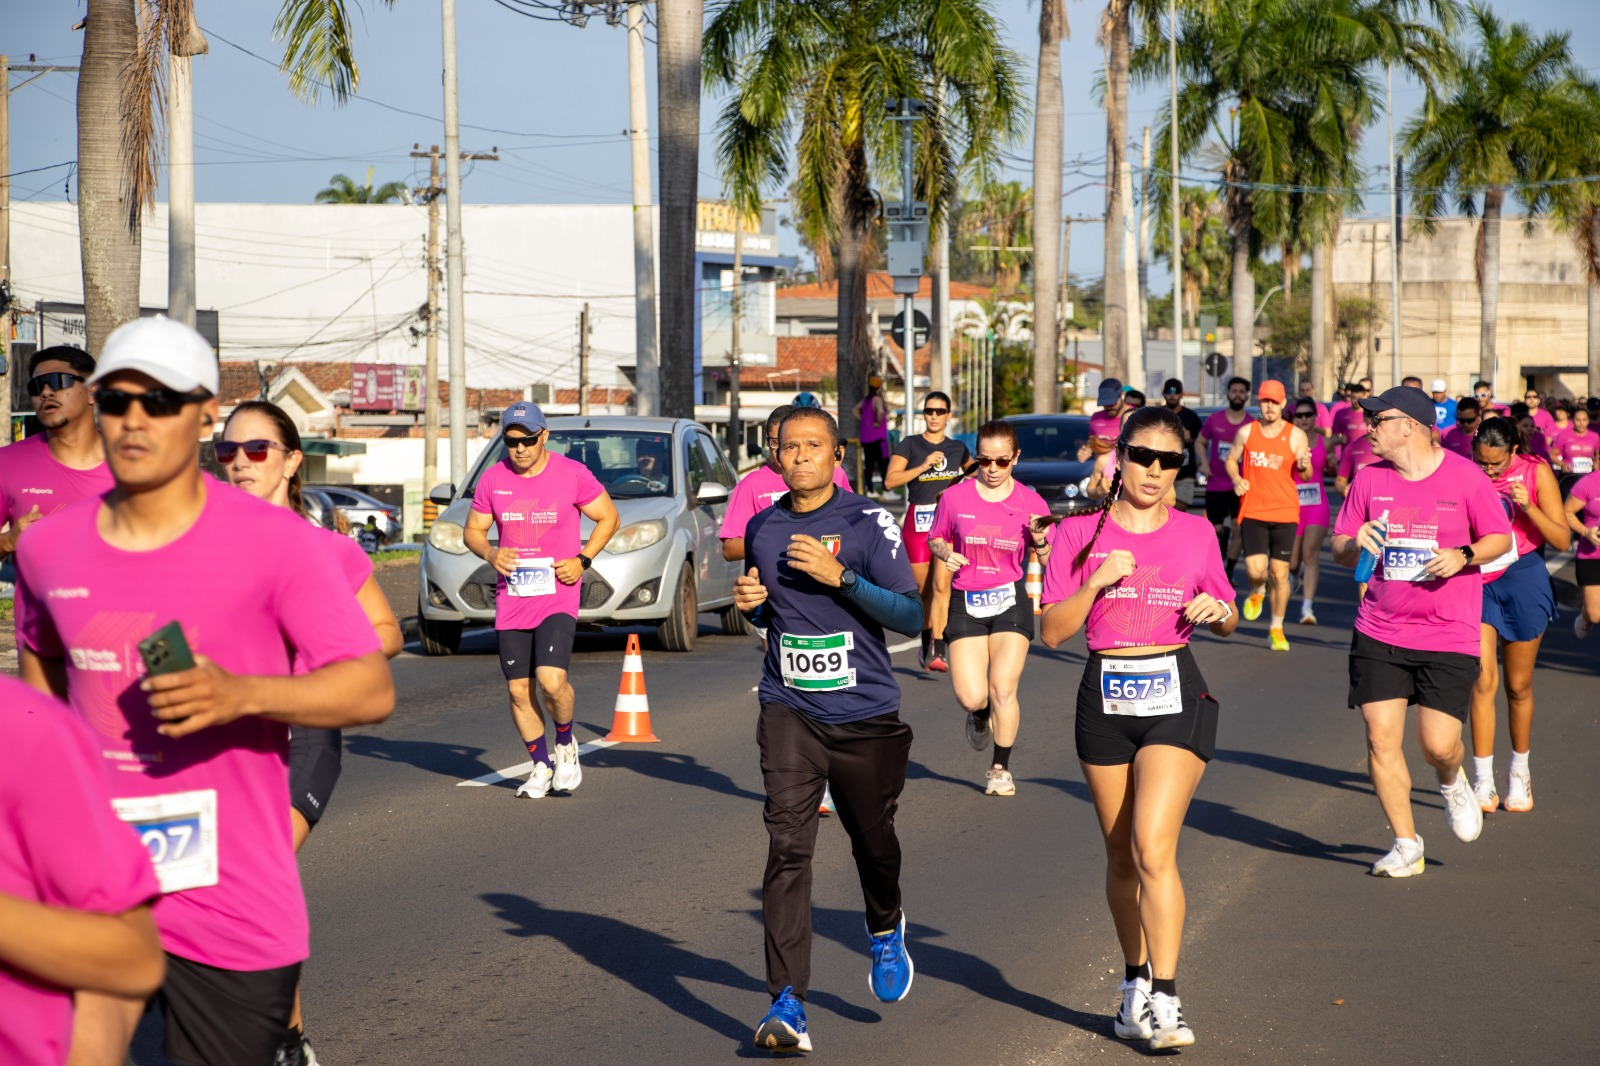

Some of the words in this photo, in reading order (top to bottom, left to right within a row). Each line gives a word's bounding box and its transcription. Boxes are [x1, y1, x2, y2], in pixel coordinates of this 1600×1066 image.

[1389, 552, 1425, 568] 5331
[510, 571, 545, 585] 5172
[972, 592, 1004, 606] 5161
[1147, 593, 1182, 601] EXPERIENCE
[1147, 599, 1181, 607] RUNNING
[786, 652, 842, 673] 1069
[1109, 677, 1167, 699] 5675
